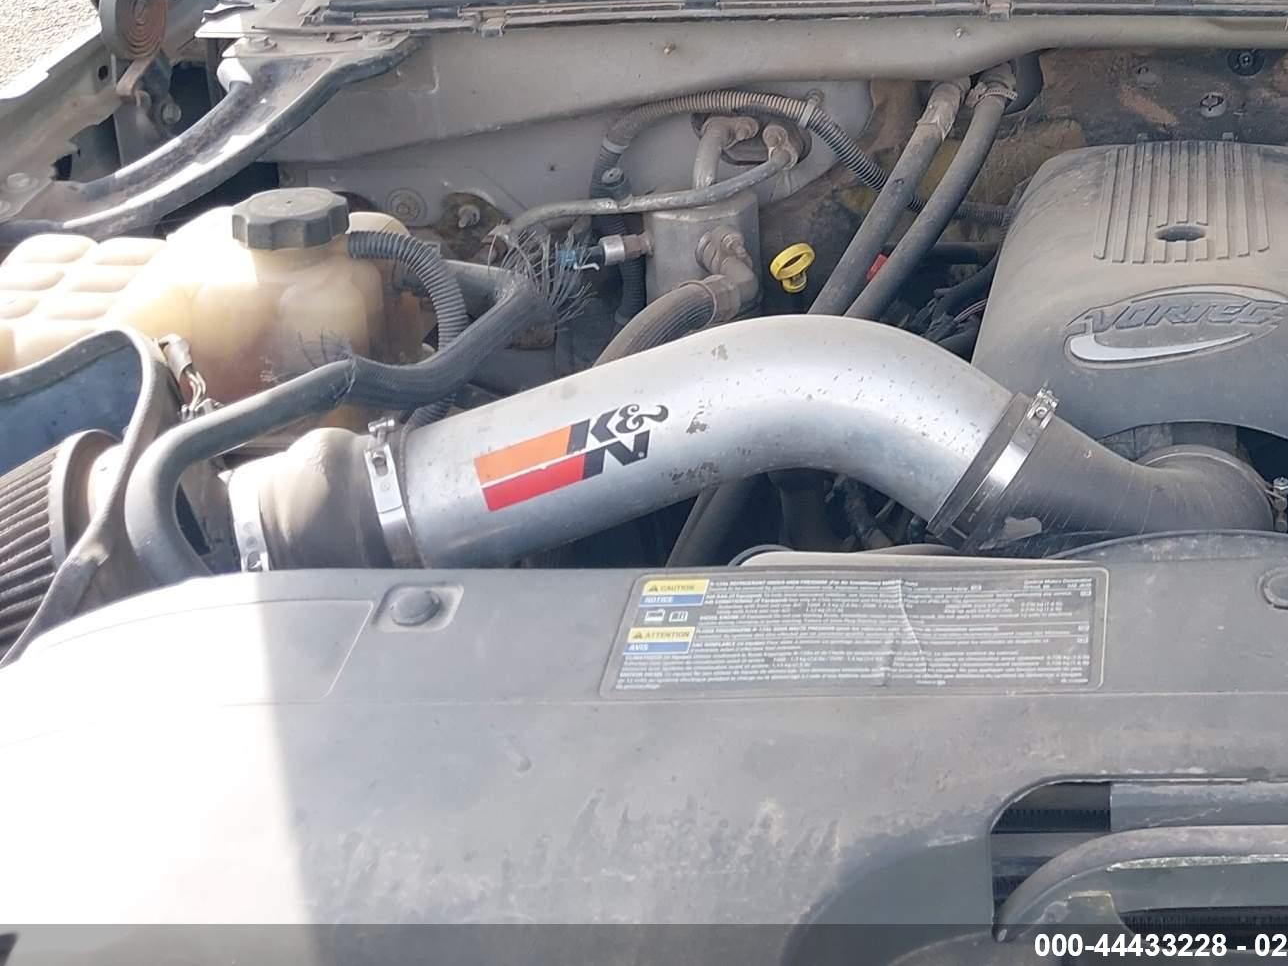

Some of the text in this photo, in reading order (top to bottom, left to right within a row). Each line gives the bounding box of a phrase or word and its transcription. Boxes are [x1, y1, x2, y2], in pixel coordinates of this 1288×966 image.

[1082, 300, 1284, 335] VORTEC
[566, 403, 669, 481] K&N
[660, 584, 696, 592] CAUTION
[644, 596, 674, 604] NOTICE
[644, 630, 690, 639] ATTENTION
[628, 643, 649, 651] AVIS
